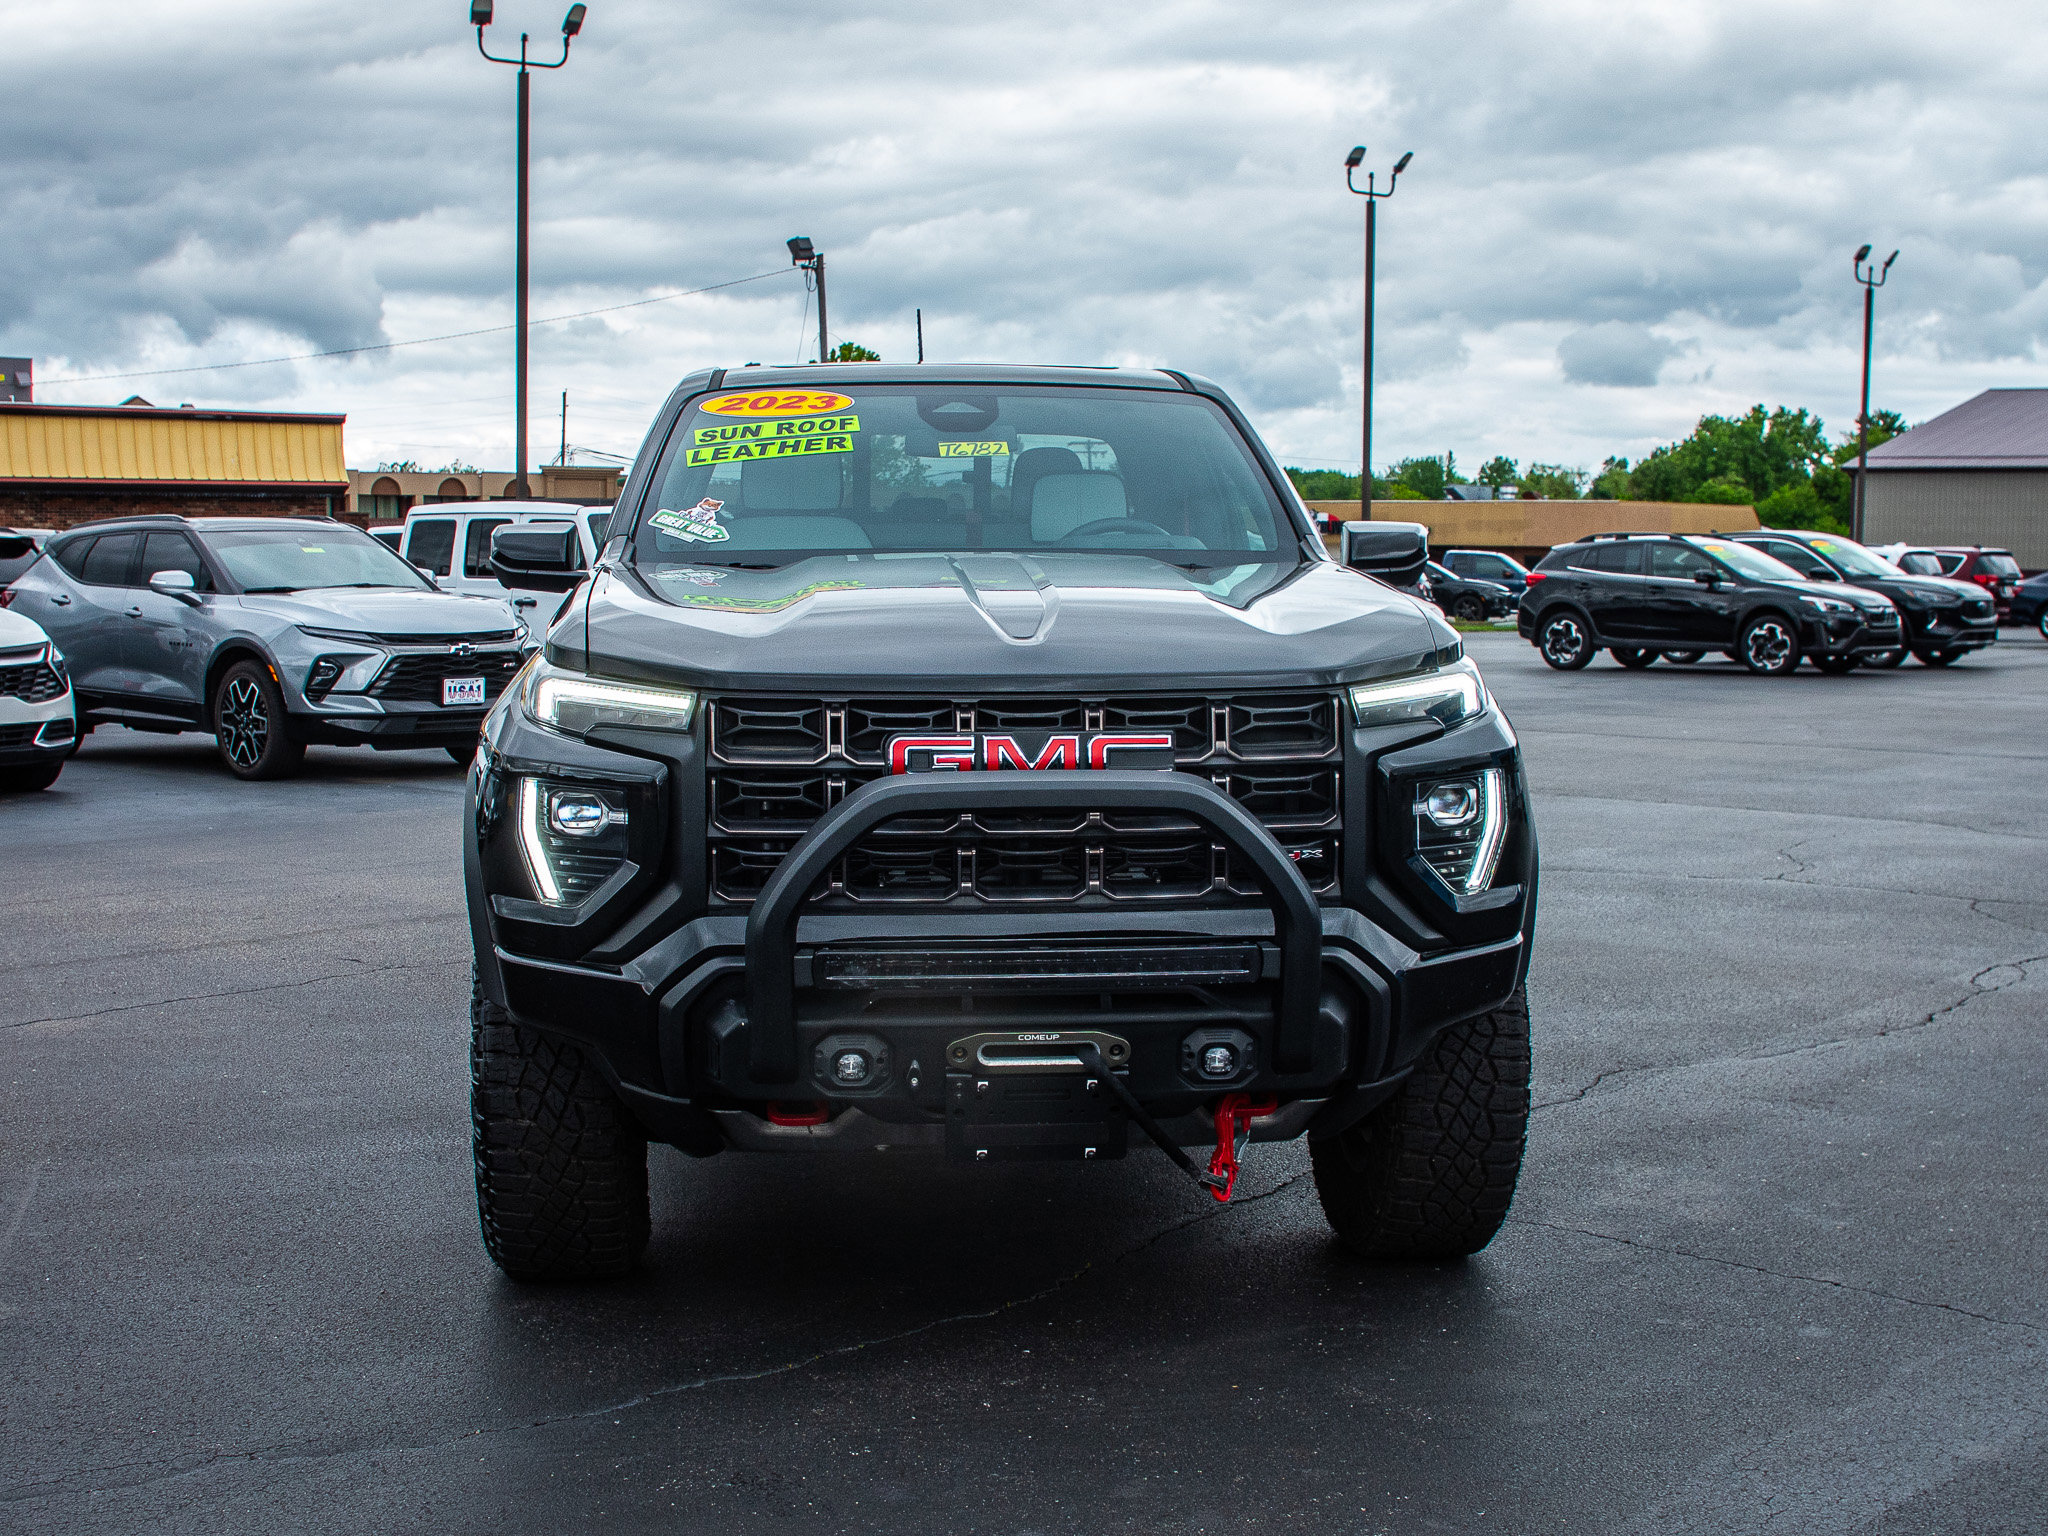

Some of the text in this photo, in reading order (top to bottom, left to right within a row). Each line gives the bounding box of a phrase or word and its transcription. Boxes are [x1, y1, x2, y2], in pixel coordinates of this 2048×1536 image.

[715, 395, 839, 412] 2023
[699, 417, 854, 442] SUN ROOF
[691, 436, 848, 464] LEATHER
[656, 514, 691, 530] GREAT
[686, 522, 720, 539] VALUE
[889, 734, 1173, 775] GMC
